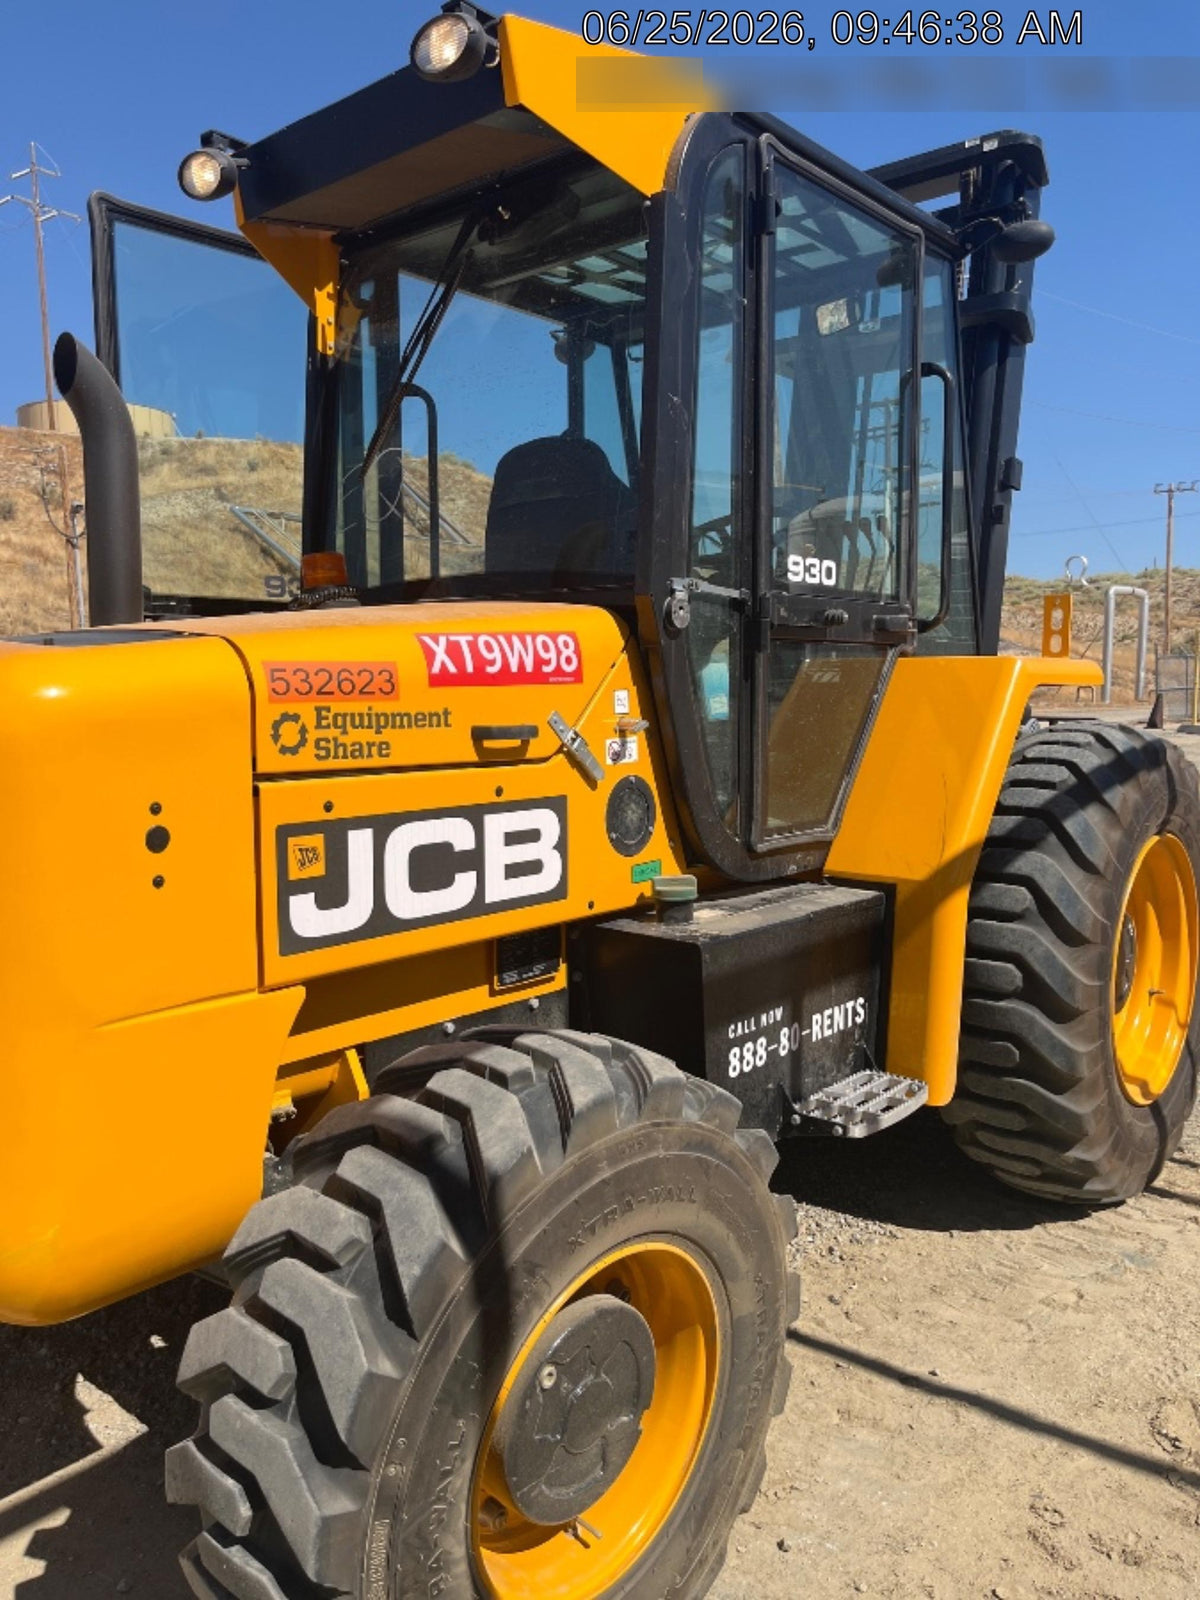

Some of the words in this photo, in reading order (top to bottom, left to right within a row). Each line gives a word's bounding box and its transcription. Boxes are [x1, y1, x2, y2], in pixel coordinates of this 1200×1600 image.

[787, 554, 837, 586] 930
[420, 634, 578, 674] XT9W98
[269, 667, 396, 697] 532623
[314, 704, 453, 735] Equipment
[314, 736, 391, 761] Share
[289, 807, 564, 939] JCB
[728, 1017, 756, 1039] CALL
[761, 1006, 784, 1028] NOW
[728, 997, 866, 1078] 888-80-RENTS
